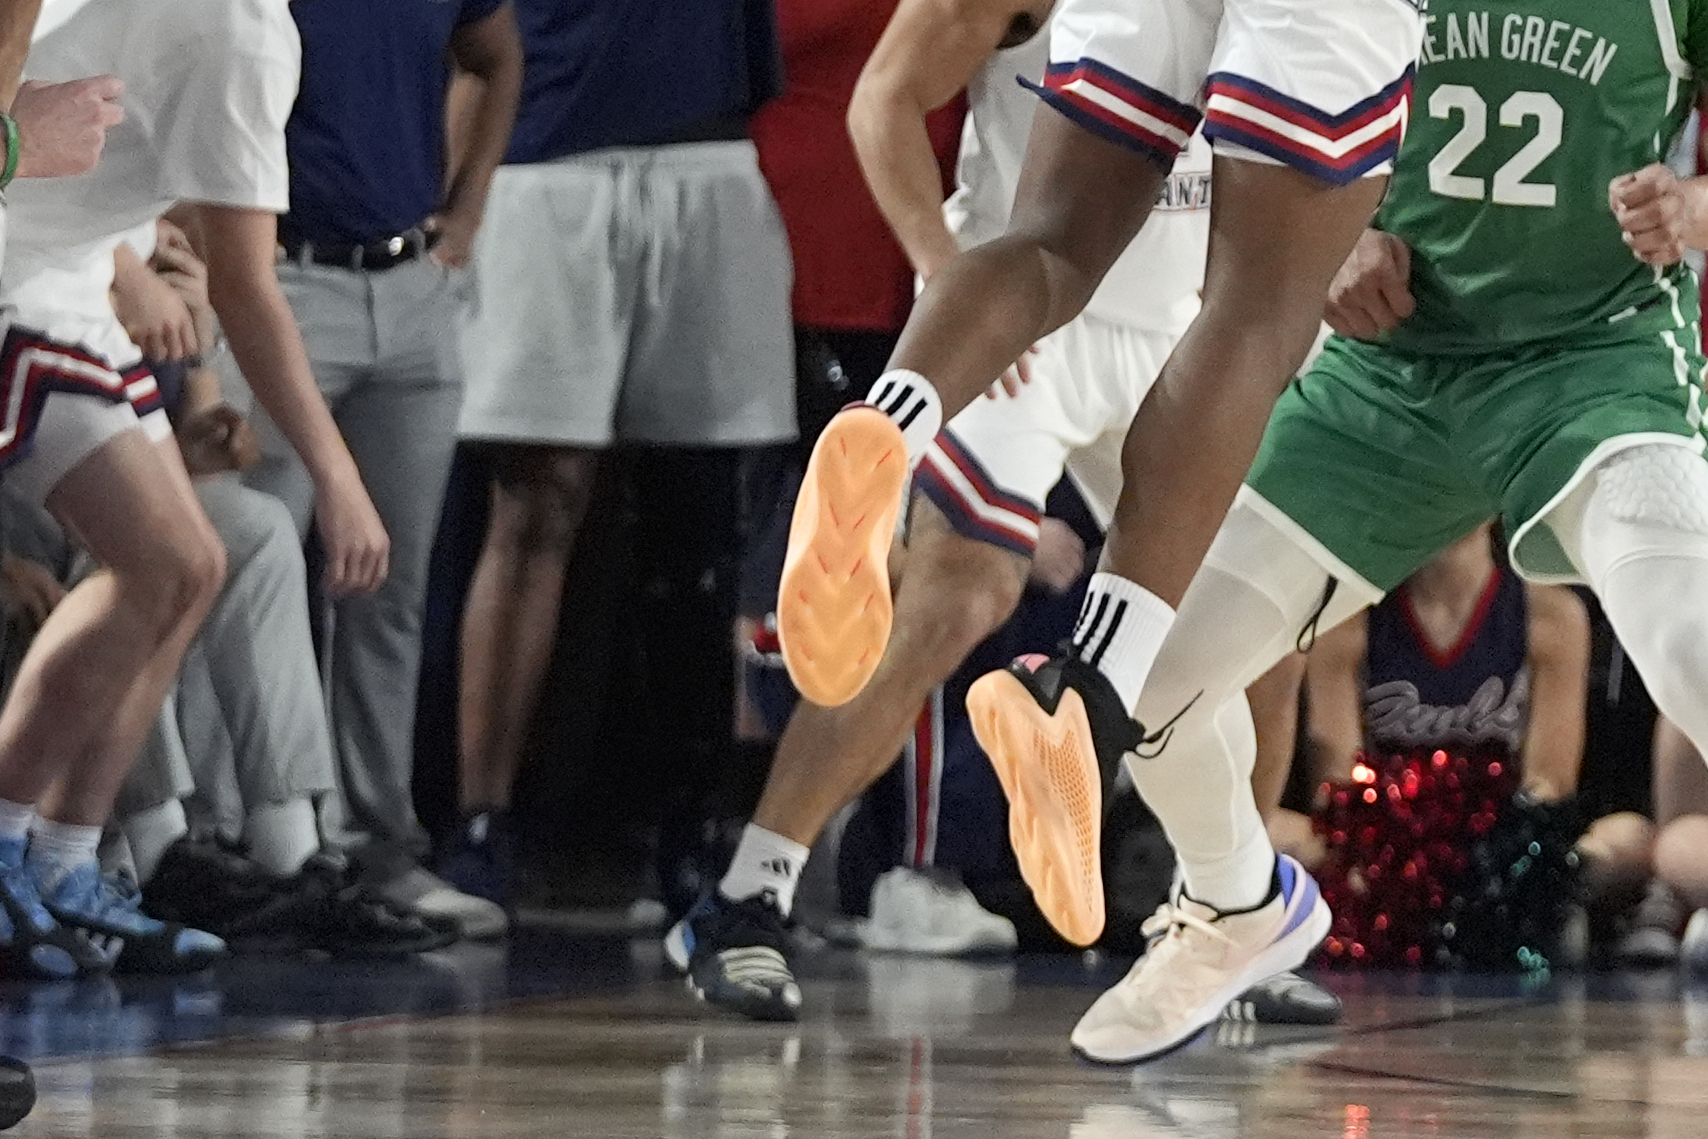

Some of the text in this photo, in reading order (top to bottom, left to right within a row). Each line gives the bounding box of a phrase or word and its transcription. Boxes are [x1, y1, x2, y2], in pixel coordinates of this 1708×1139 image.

[1417, 10, 1619, 87] EAN GREEN
[1427, 83, 1565, 208] 22
